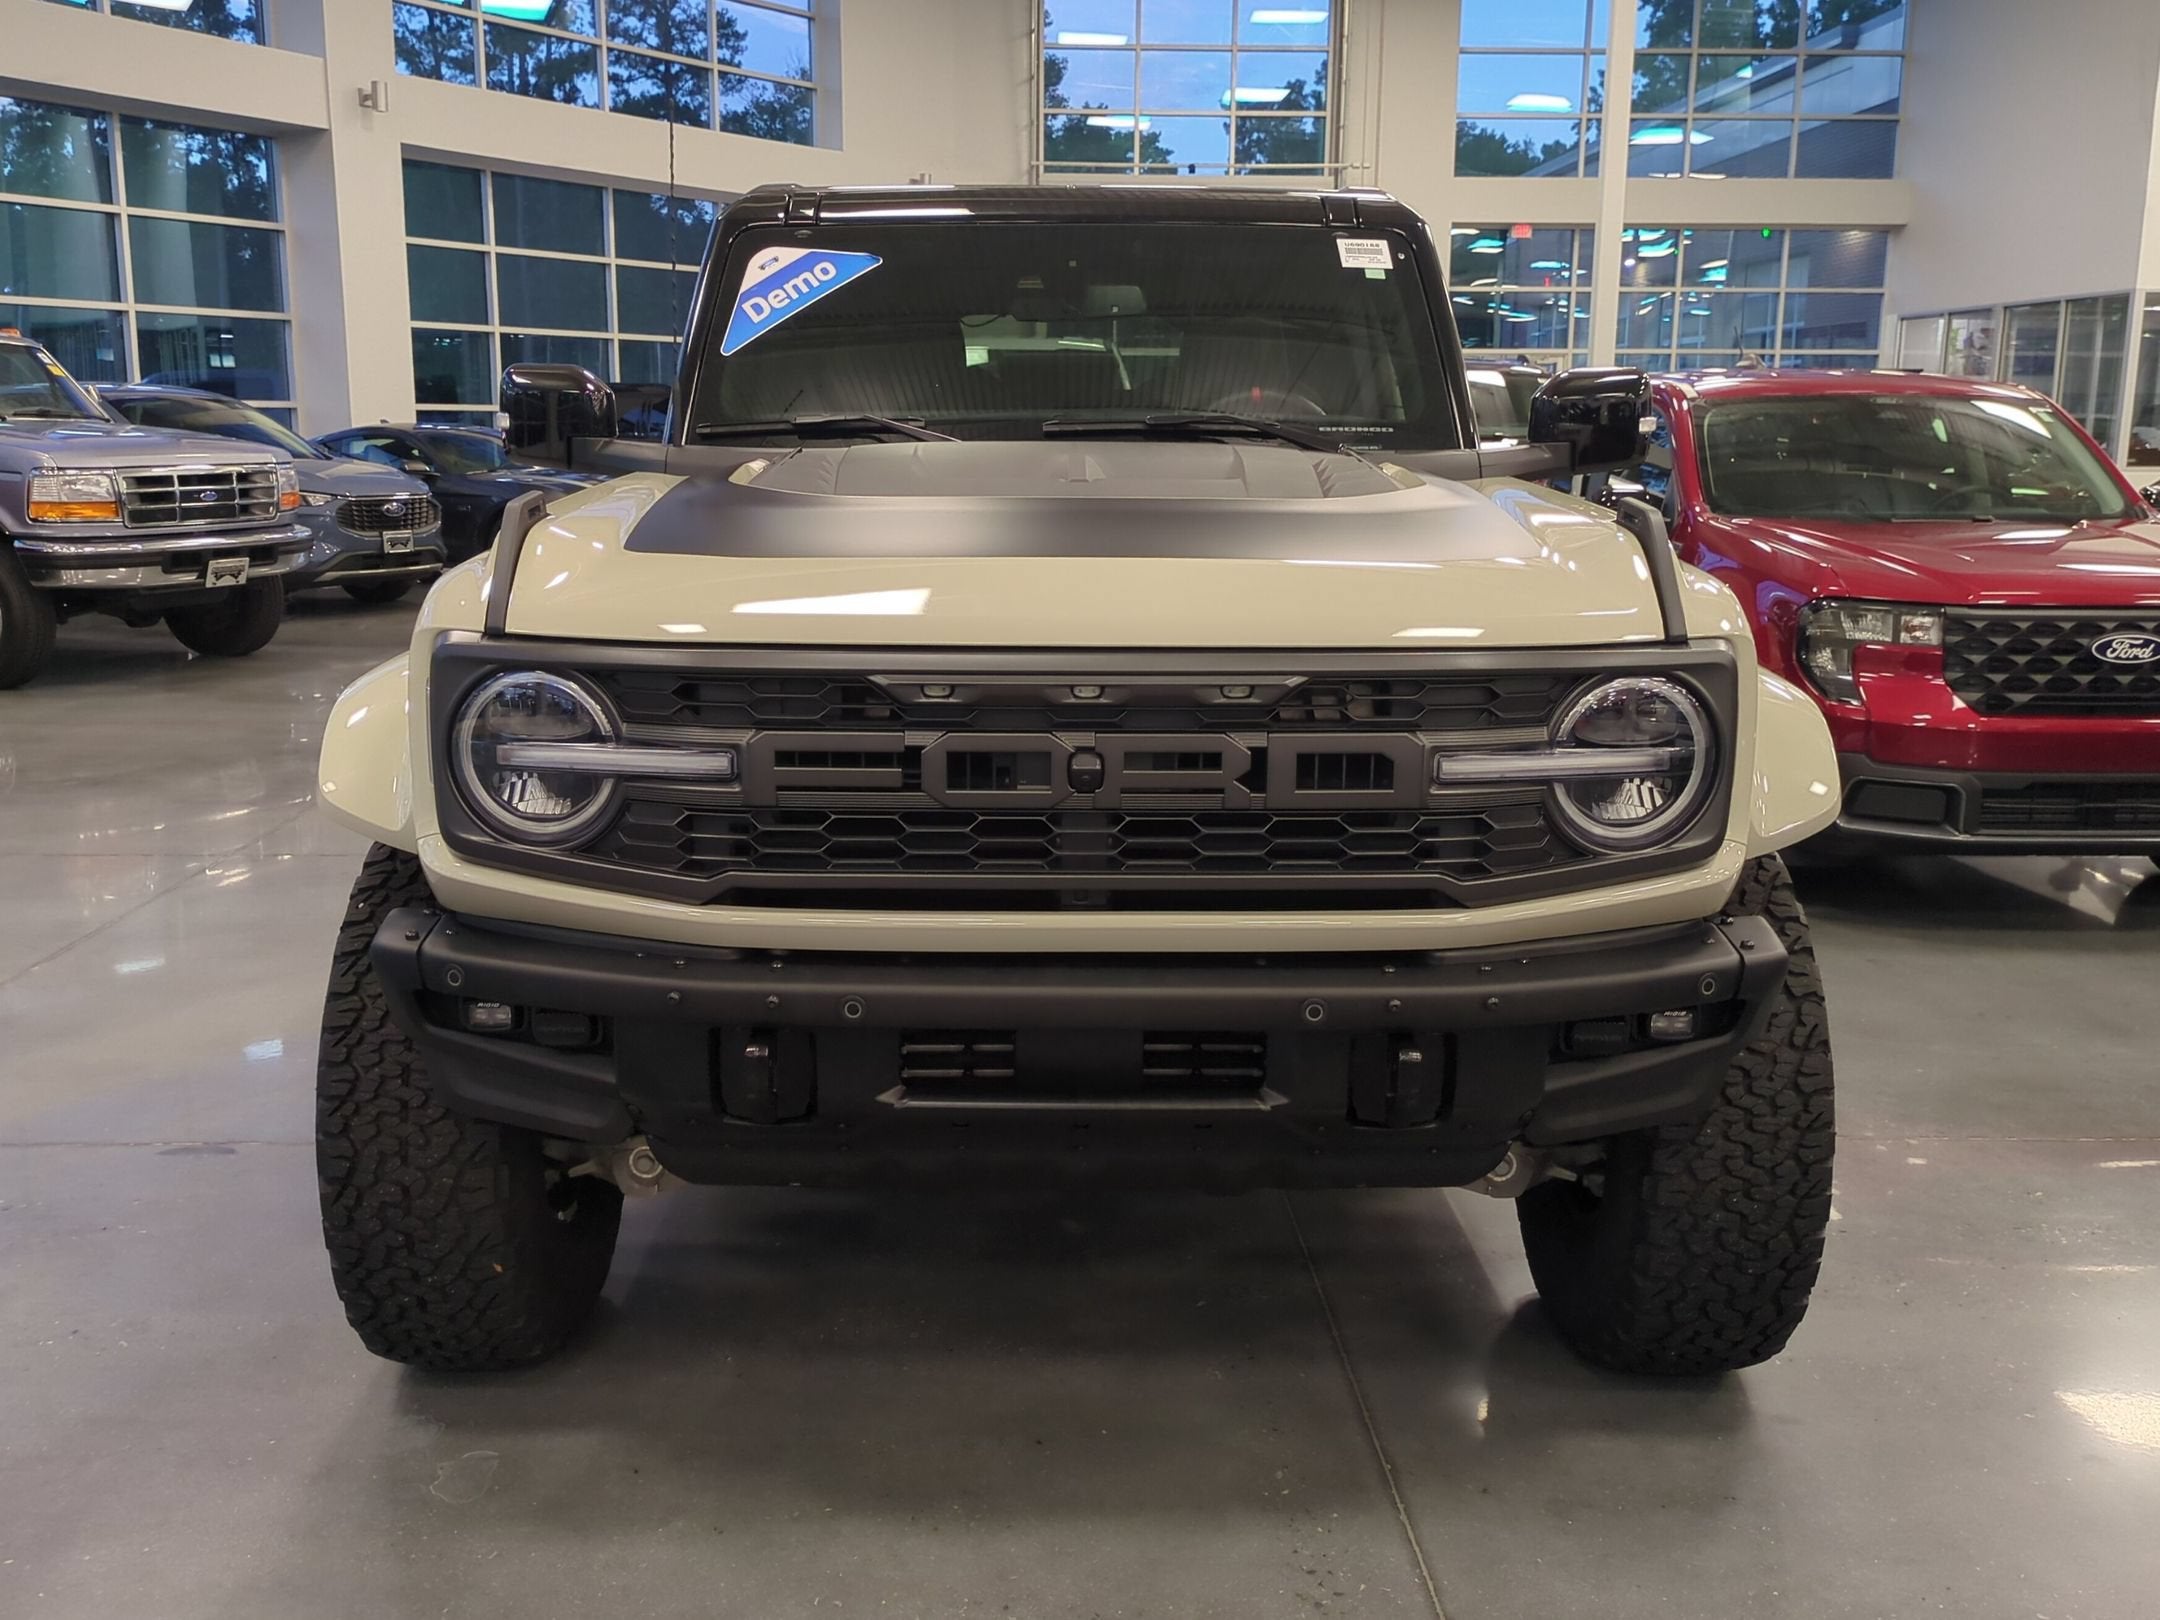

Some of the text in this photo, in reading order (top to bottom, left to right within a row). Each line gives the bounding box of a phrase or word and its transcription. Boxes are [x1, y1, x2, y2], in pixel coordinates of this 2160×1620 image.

[742, 261, 837, 324] Demo
[2106, 638, 2155, 659] Ford
[744, 731, 1426, 810] FORD
